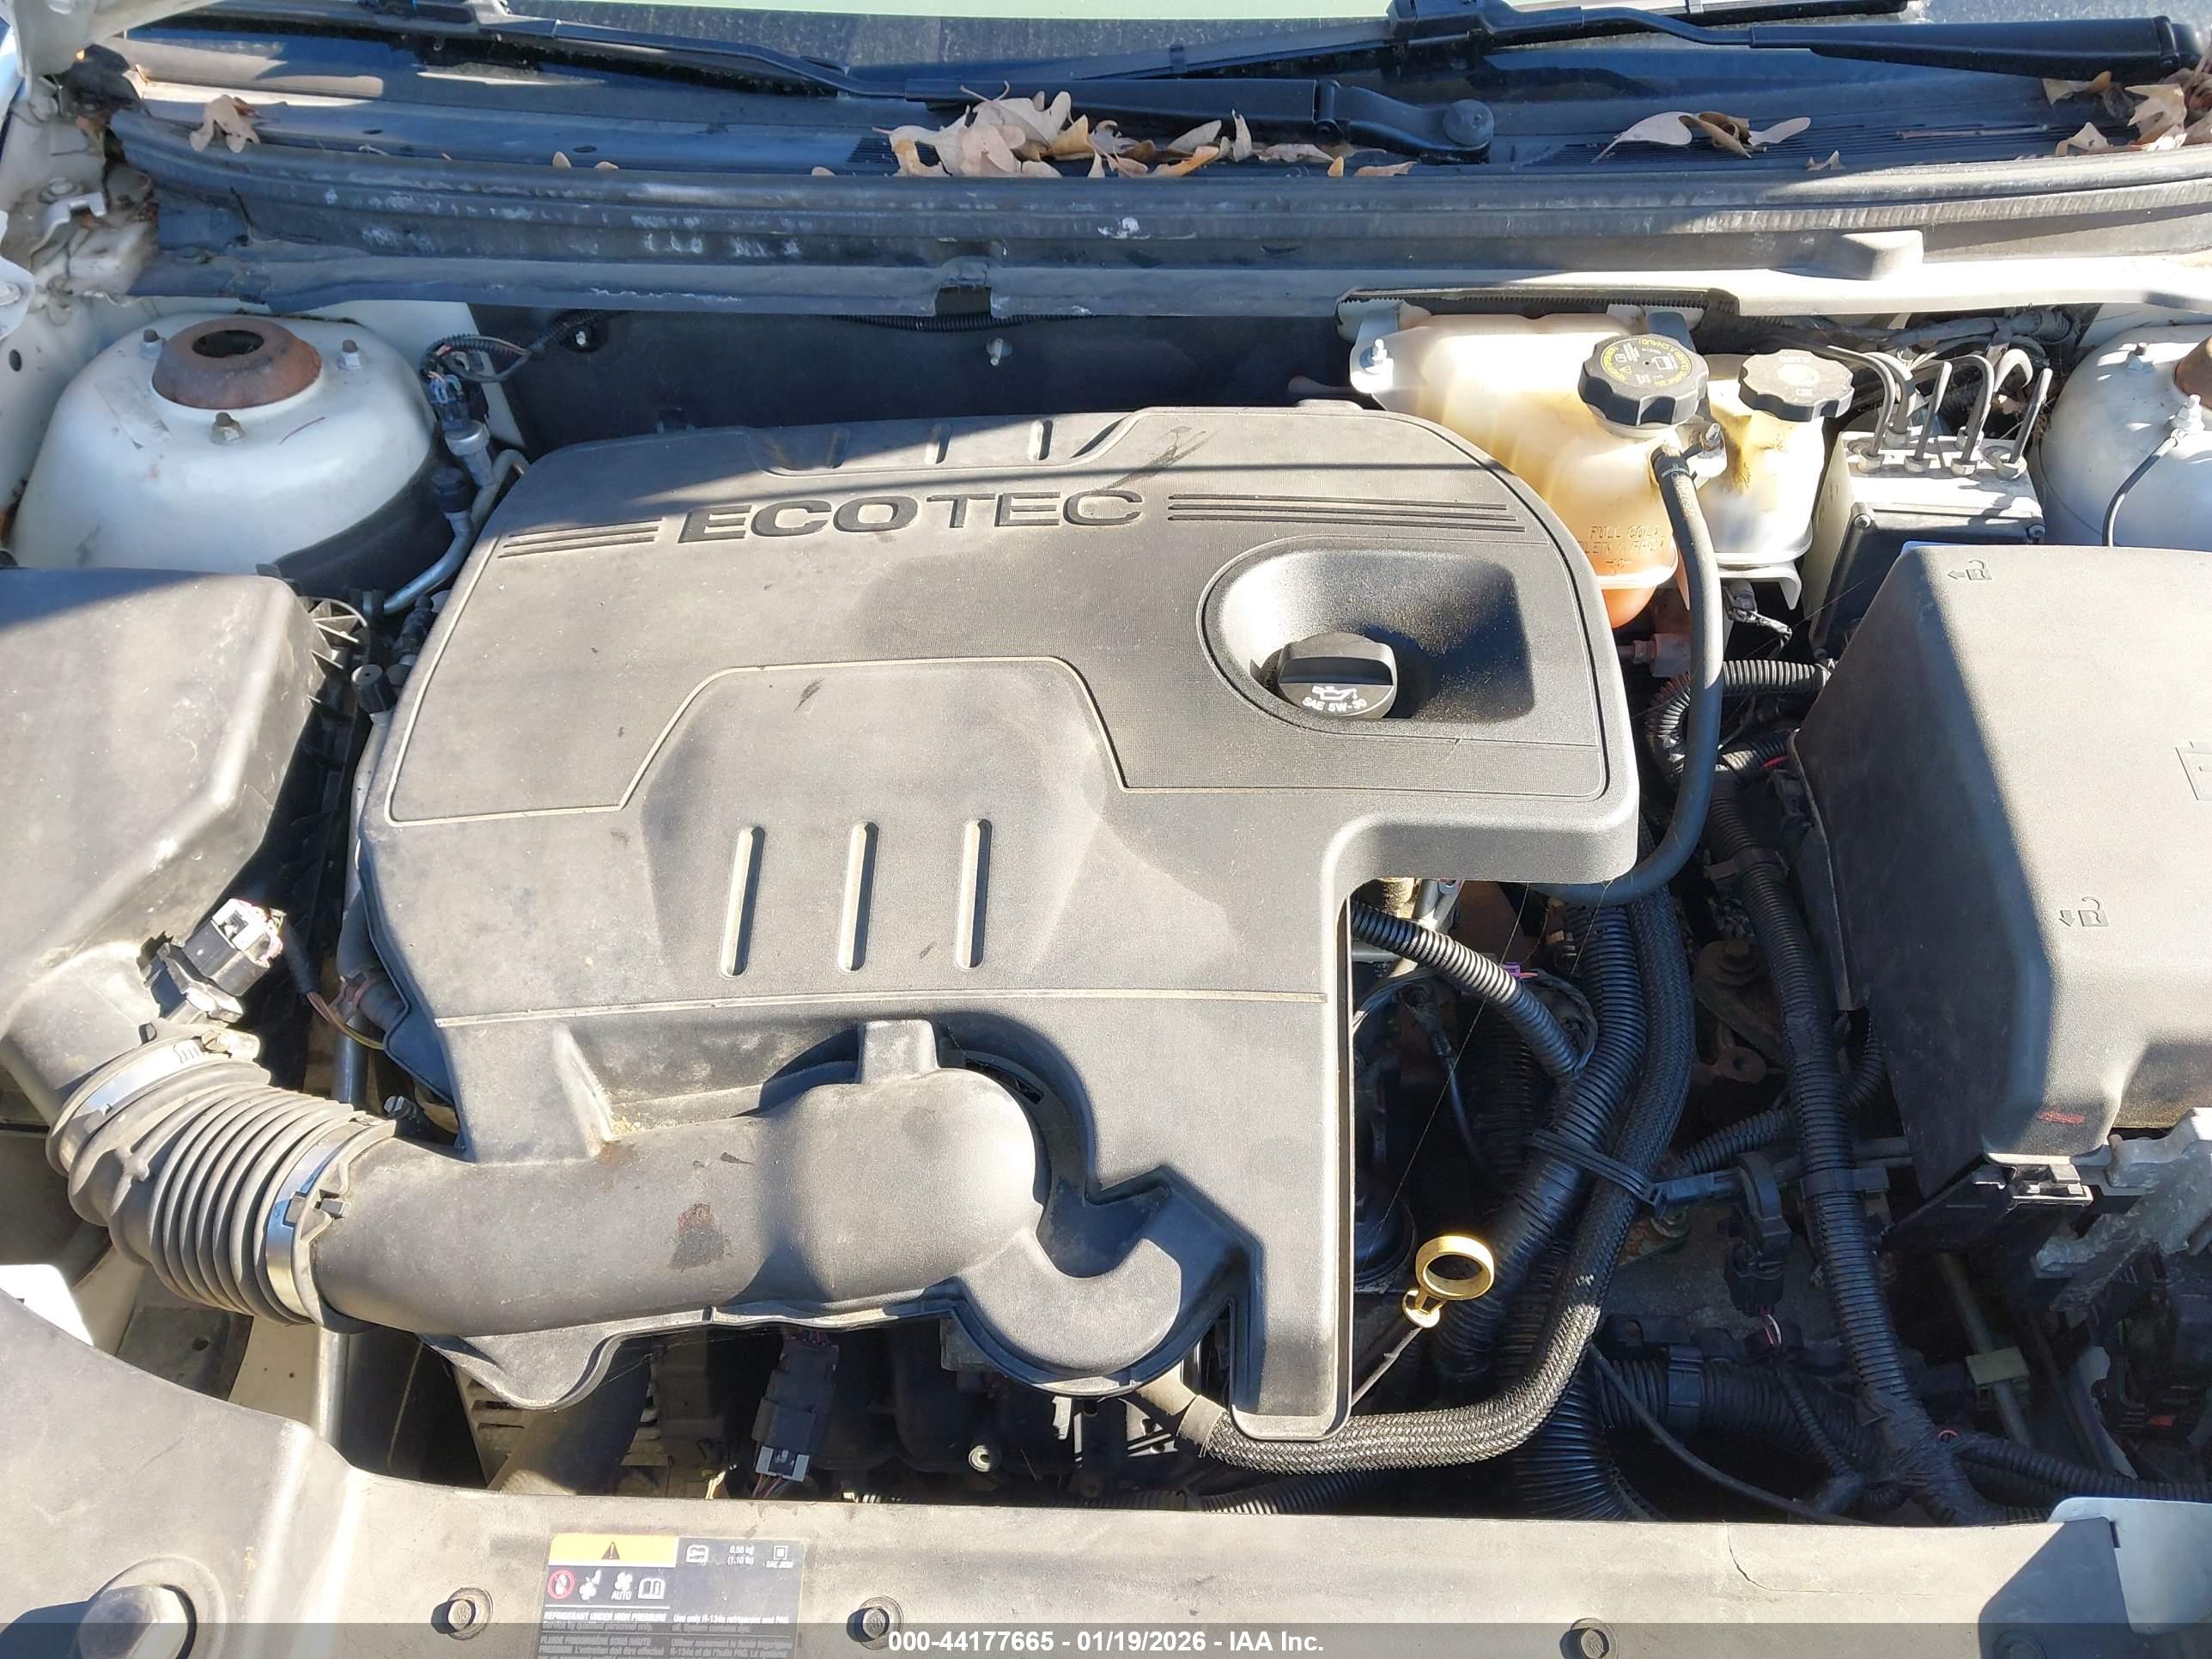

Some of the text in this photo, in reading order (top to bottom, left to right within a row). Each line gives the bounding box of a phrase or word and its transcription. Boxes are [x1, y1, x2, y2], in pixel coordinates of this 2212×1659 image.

[678, 489, 1144, 544] ECOTEC
[1589, 525, 1659, 540] FULL COLD
[1302, 696, 1368, 712] SAE 5W-30
[611, 1590, 632, 1601] AUTO
[544, 1611, 590, 1620] REFRIGERANT
[589, 1613, 613, 1621] UNDER
[631, 1613, 666, 1622] PRESSURE
[673, 1614, 686, 1623] Use
[702, 1614, 726, 1624] R-134a
